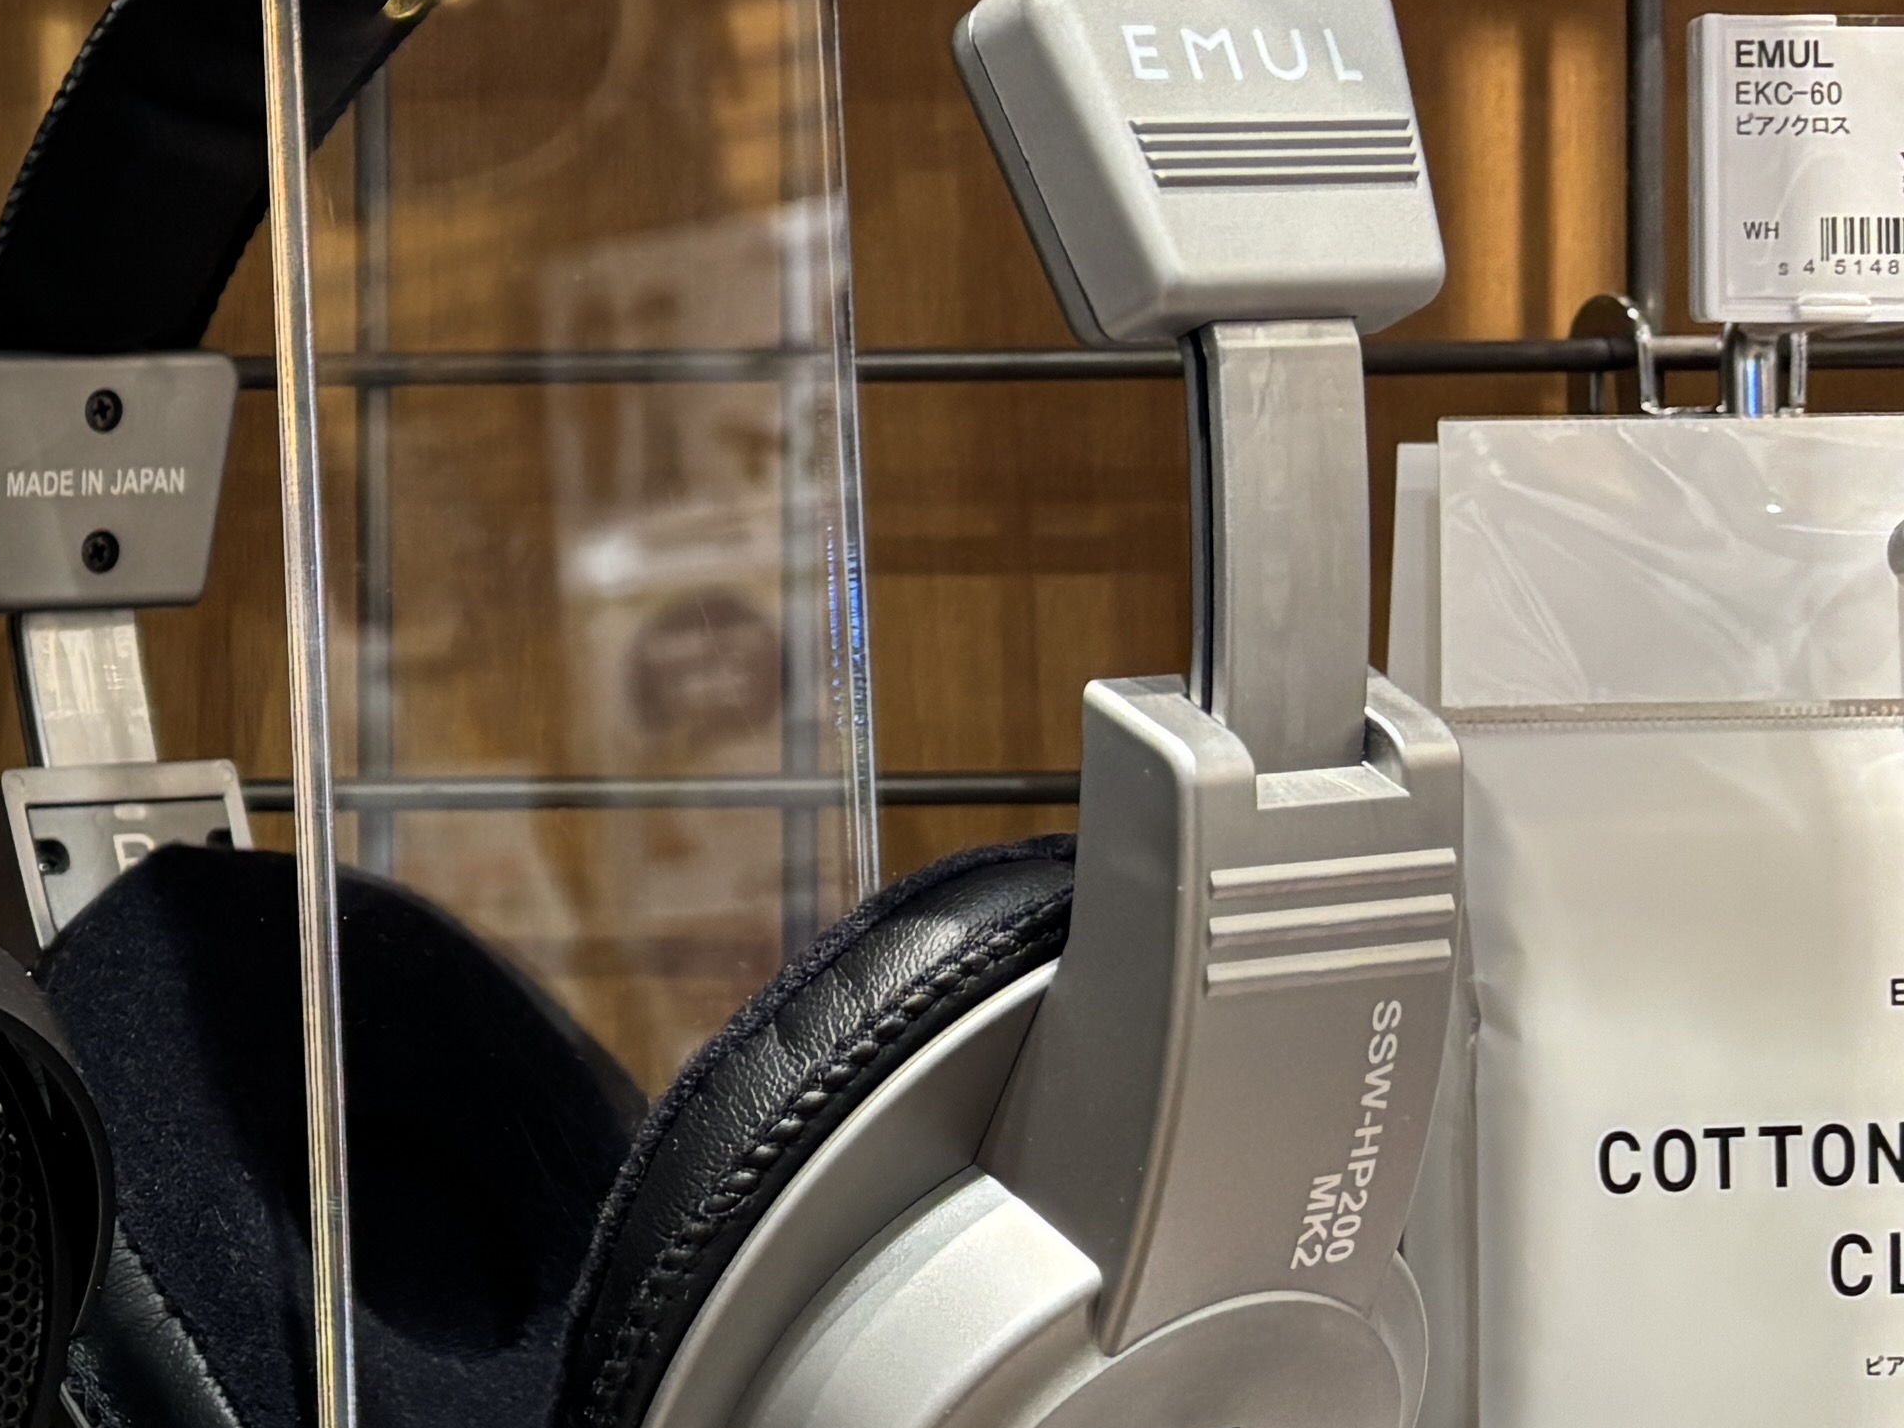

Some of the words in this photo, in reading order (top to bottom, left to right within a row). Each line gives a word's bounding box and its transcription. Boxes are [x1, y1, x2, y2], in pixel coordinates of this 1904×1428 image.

[1121, 23, 1364, 82] EMUL
[1734, 39, 1835, 69] EMUL
[1735, 81, 1843, 106] EKC-60
[1736, 113, 1851, 136] ピアノクロス
[1743, 221, 1780, 240] WH
[6, 470, 74, 498] MADE
[81, 469, 103, 496] IN
[109, 467, 185, 495] JAPAN
[1324, 999, 1402, 1264] SSW-HP200
[1597, 1121, 1904, 1195] COTTON
[1291, 1172, 1342, 1270] MK2
